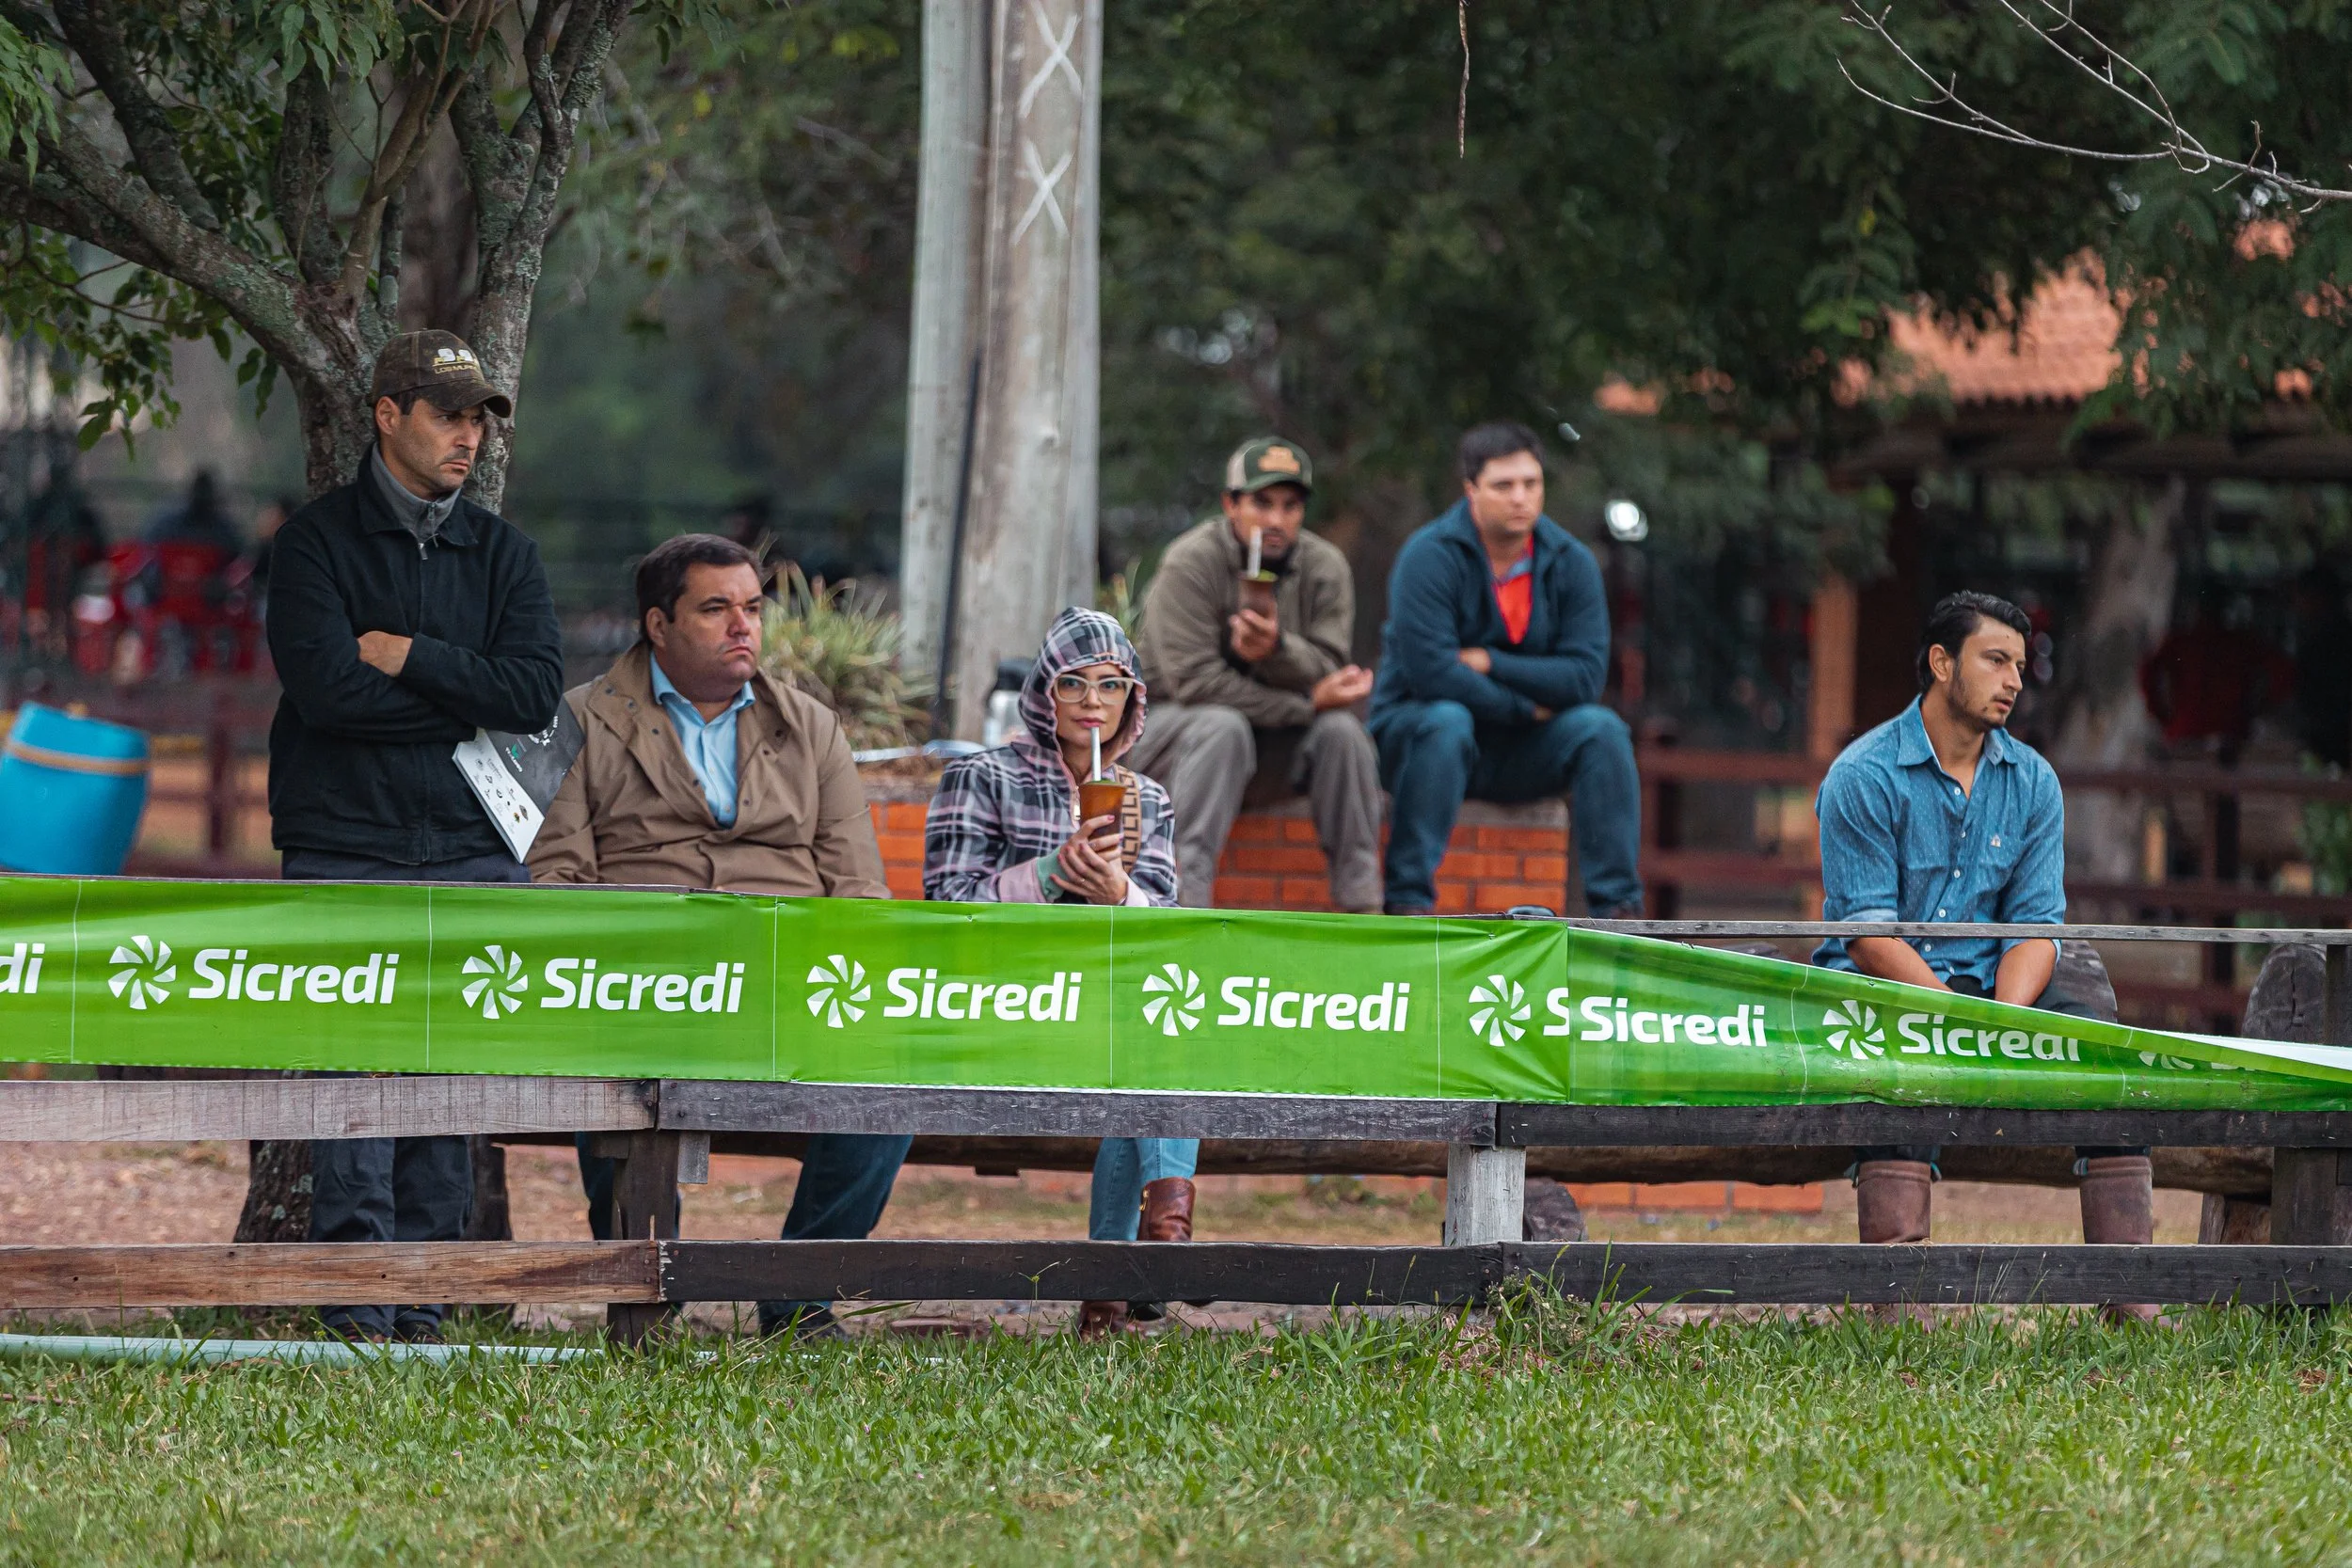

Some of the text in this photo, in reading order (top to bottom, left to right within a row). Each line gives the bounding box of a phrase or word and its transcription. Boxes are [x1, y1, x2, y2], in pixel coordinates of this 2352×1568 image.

[189, 949, 400, 1004] Sicredi
[540, 958, 745, 1013] Sicredi
[882, 967, 1083, 1022] Sicredi
[1216, 976, 1410, 1032] Sicredi
[1580, 996, 1768, 1048] Sicredi
